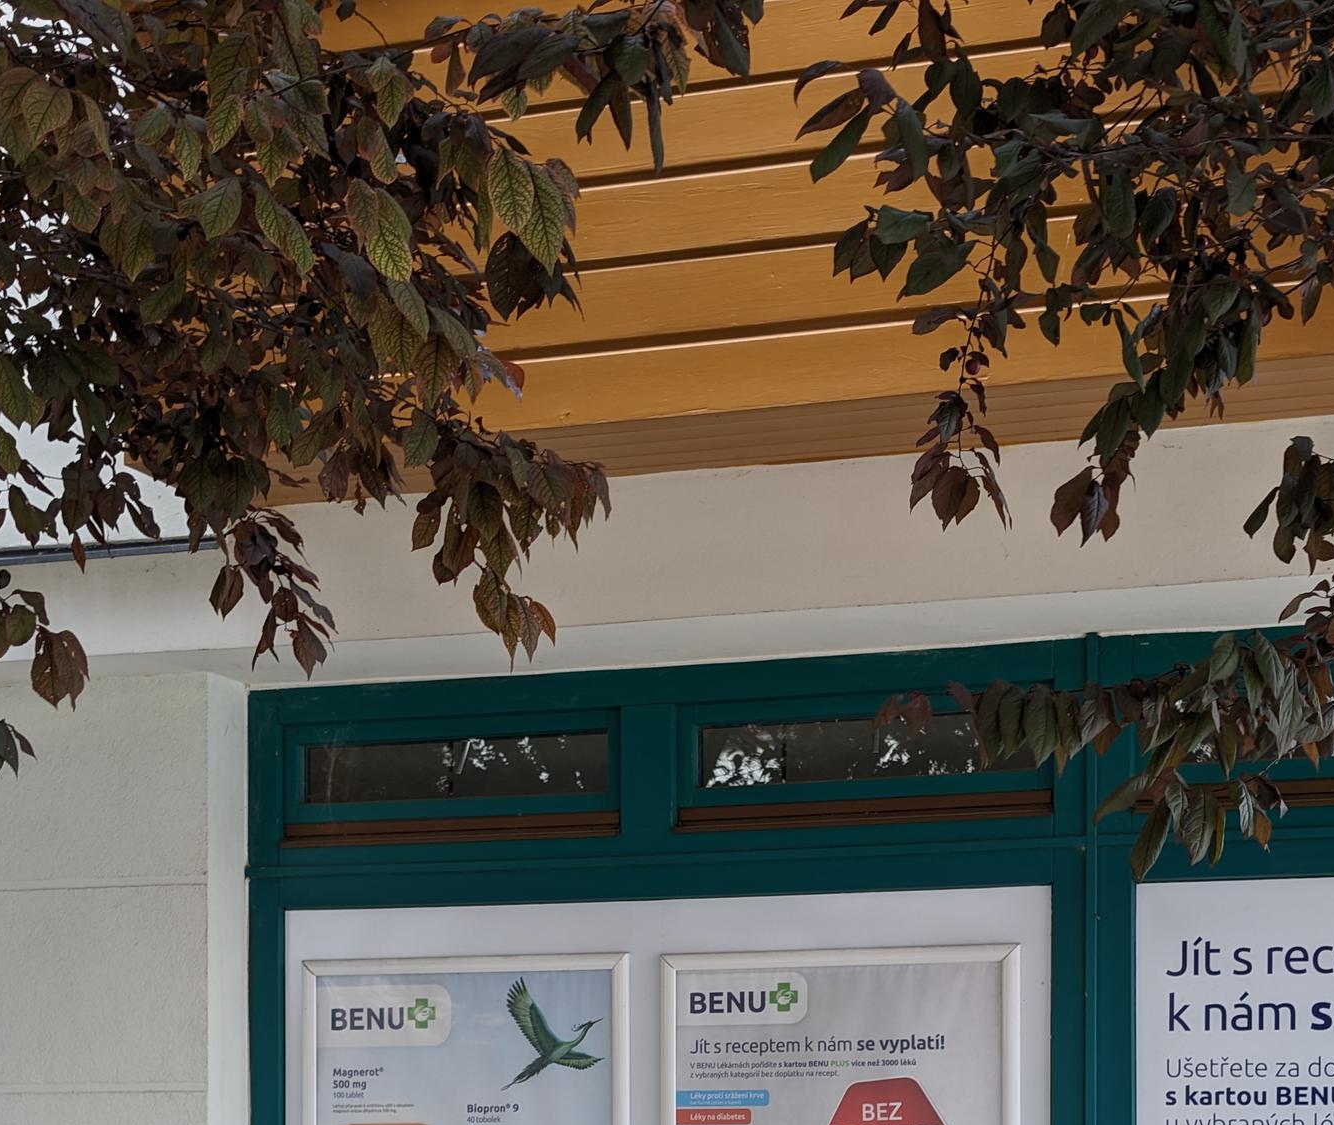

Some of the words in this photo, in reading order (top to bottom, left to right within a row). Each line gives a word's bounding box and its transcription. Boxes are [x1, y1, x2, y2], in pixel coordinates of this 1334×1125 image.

[1165, 936, 1221, 977] Jít
[1232, 945, 1253, 976] s
[689, 991, 767, 1014] BENU
[1168, 992, 1191, 1032] k
[1203, 991, 1297, 1031] nám
[330, 1007, 405, 1031] BENU
[690, 1038, 711, 1054] Jít
[714, 1042, 721, 1053] s
[725, 1038, 800, 1056] receptem
[805, 1036, 813, 1052] k
[817, 1035, 852, 1052] nám
[857, 1039, 875, 1051] se
[879, 1034, 945, 1053] vyplatí!
[1166, 1057, 1268, 1078] Ušetřete
[1275, 1062, 1300, 1078] za
[333, 1080, 350, 1089] 500
[352, 1081, 367, 1090] mg
[346, 1091, 364, 1099] tablet
[1165, 1089, 1177, 1106] s
[1185, 1086, 1267, 1106] kartou
[512, 1103, 519, 1113] 9
[690, 1113, 706, 1121] Léky
[862, 1102, 903, 1121] BEZ
[467, 1116, 475, 1124] 40
[476, 1115, 501, 1123] tobolek
